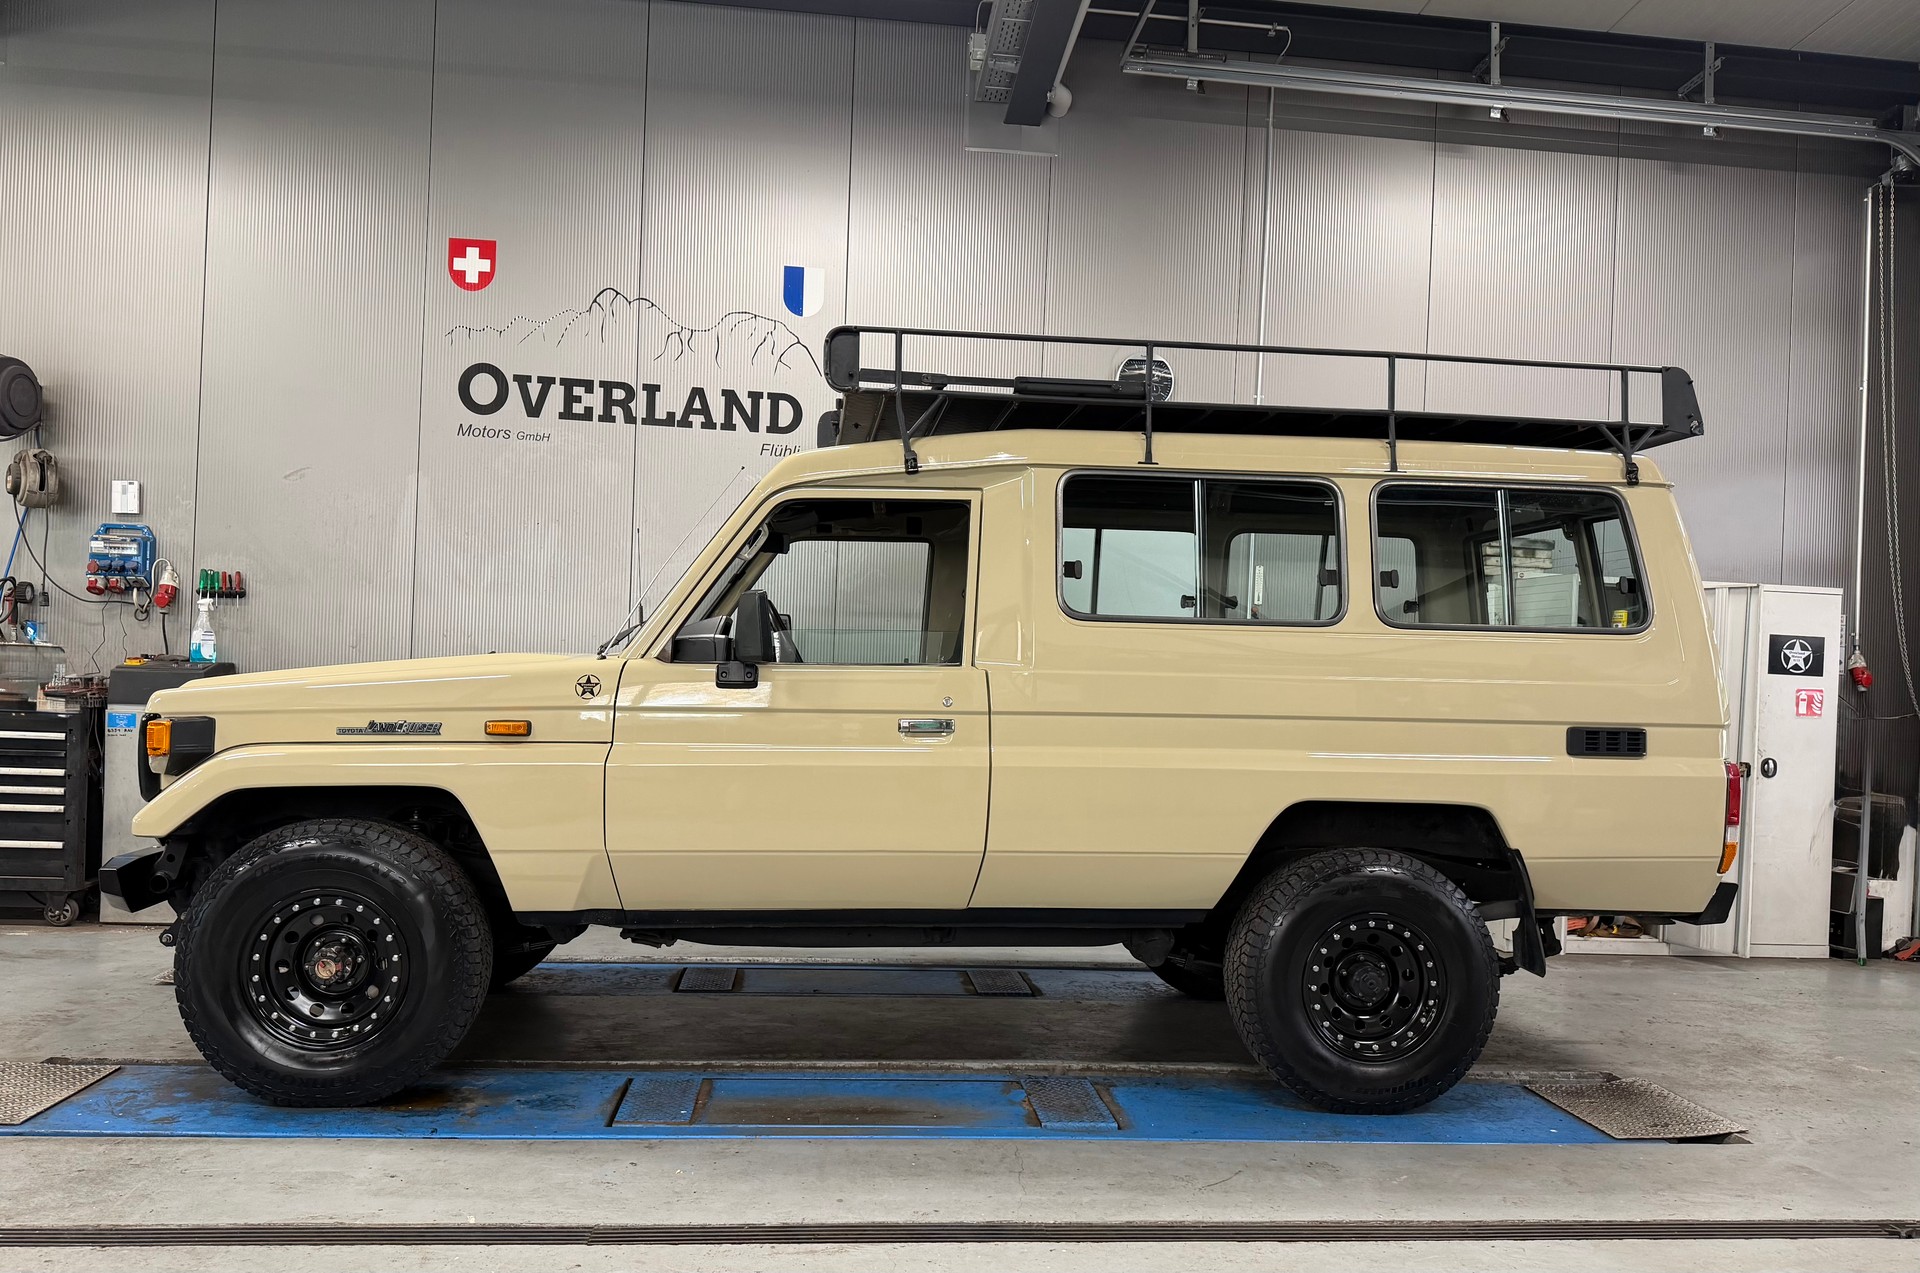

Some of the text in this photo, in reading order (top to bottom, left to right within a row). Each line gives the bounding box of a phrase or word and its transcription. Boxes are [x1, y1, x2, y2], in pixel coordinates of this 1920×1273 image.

[457, 362, 803, 435] OVERLAND
[457, 423, 551, 442] Motors GmbH
[759, 443, 801, 457] Flühli
